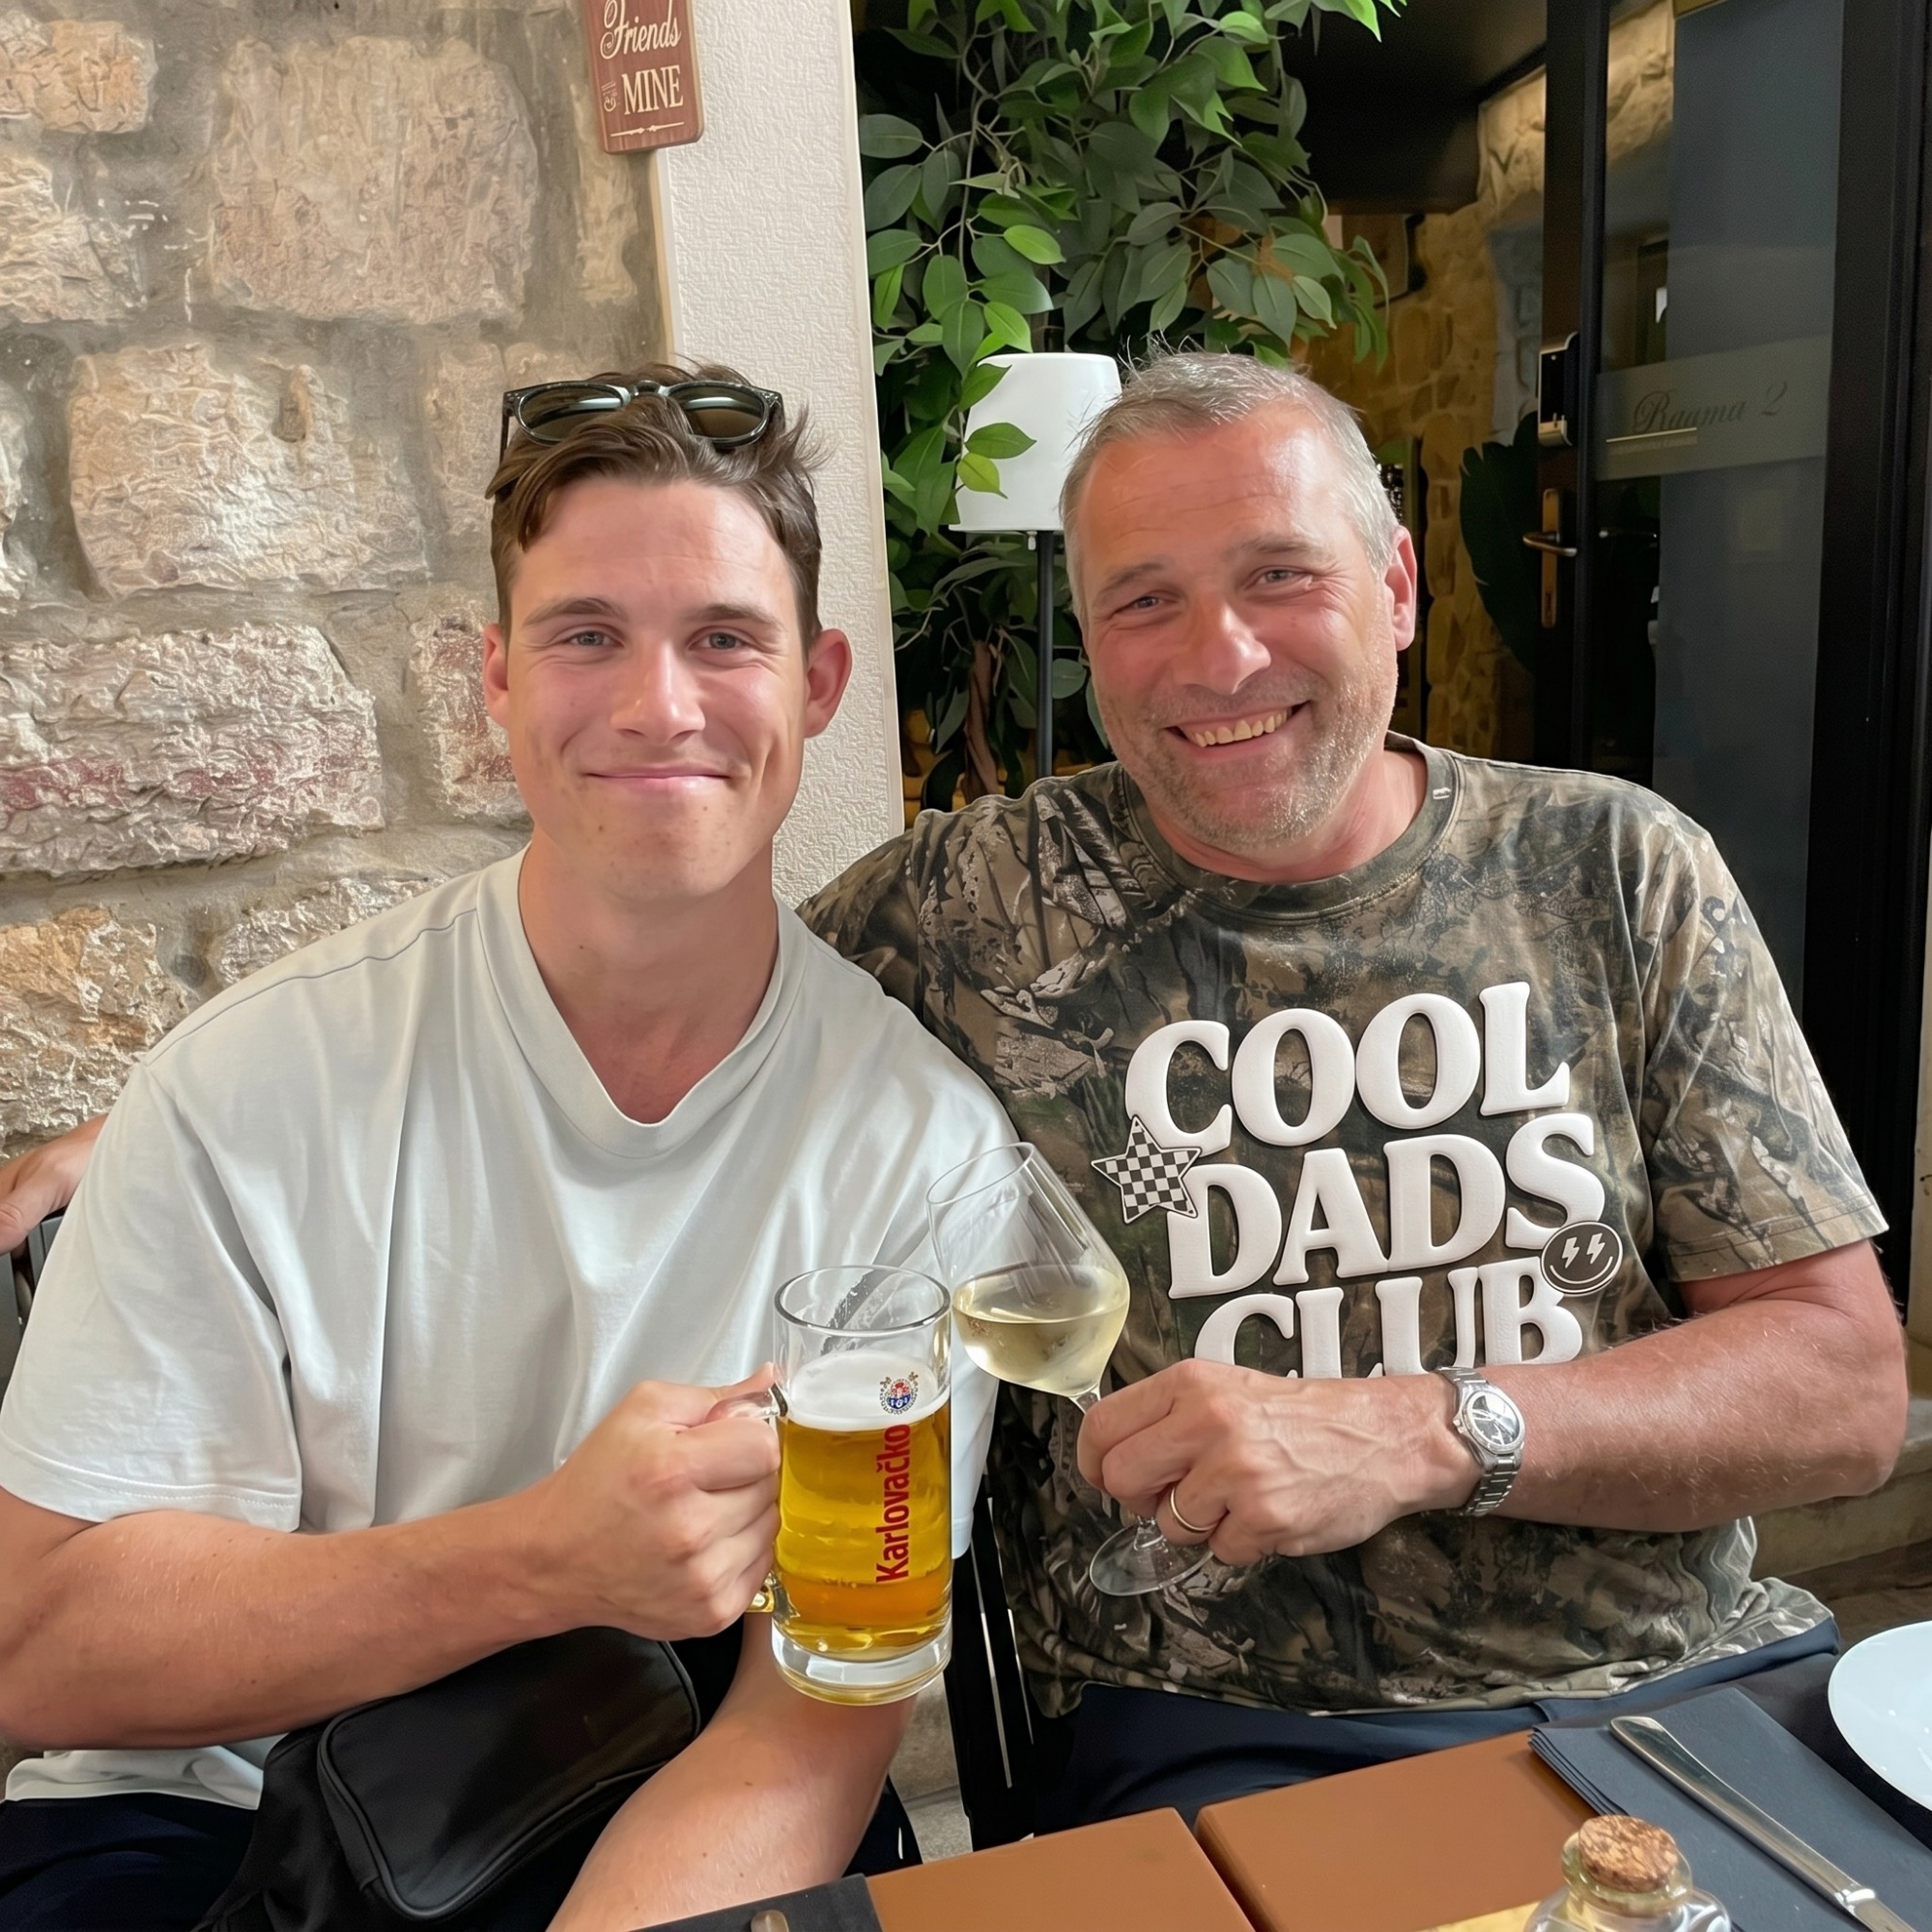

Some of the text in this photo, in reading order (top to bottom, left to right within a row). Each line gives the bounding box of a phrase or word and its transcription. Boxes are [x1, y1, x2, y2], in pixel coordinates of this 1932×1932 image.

[600, 0, 682, 60] Friends
[621, 65, 684, 115] MINE
[1760, 381, 1787, 417] 2
[1124, 980, 1571, 1158] COOL
[1168, 1113, 1605, 1299] DADS
[875, 1424, 911, 1583] Karlovačko
